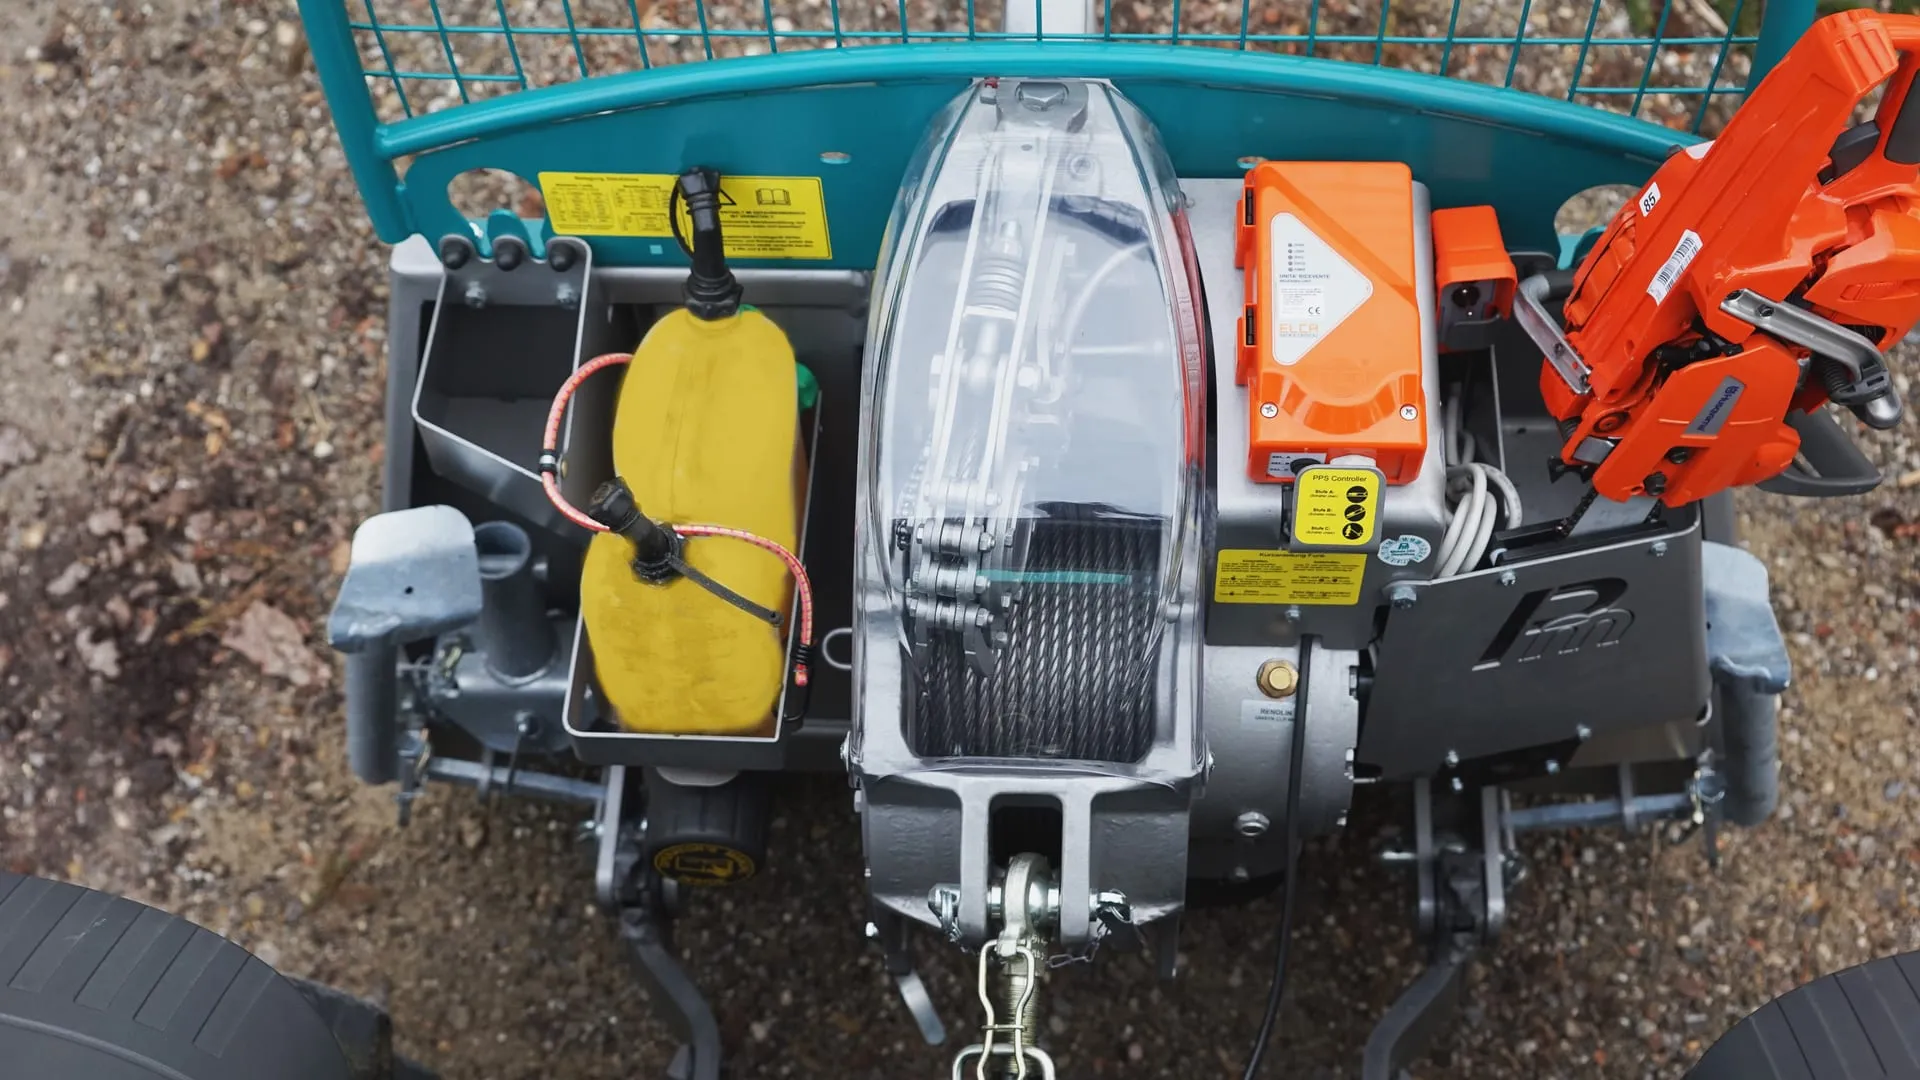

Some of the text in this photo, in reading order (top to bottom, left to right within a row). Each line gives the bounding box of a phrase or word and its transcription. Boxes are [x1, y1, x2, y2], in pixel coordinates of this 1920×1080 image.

[1643, 192, 1656, 212] 85
[1312, 474, 1330, 482] PPS
[1260, 707, 1293, 716] RENOLIN
